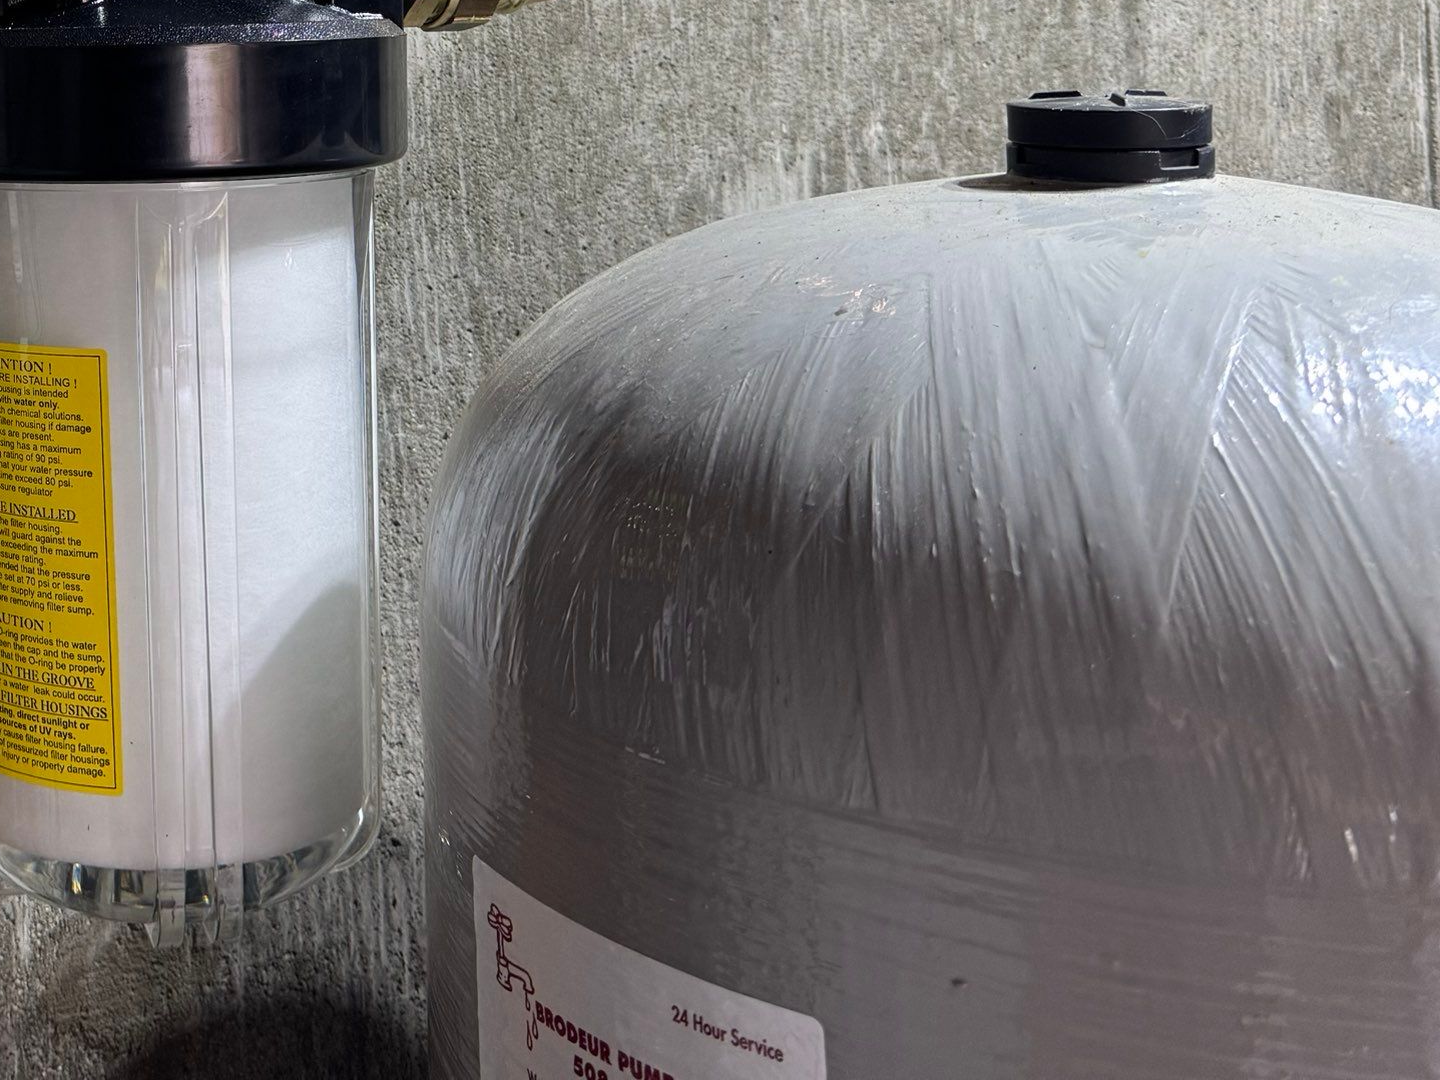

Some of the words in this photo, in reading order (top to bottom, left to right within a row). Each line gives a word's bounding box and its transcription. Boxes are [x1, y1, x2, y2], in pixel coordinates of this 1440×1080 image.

[13, 374, 71, 388] INSTALLING
[23, 387, 31, 395] is
[32, 387, 69, 399] intended
[7, 406, 41, 418] chemical
[43, 411, 84, 421] solutions.
[13, 398, 36, 407] water
[38, 400, 60, 411] only.
[7, 429, 20, 438] are
[21, 432, 55, 442] present.
[15, 420, 46, 432] housing
[55, 424, 92, 435] damage
[16, 440, 31, 451] has
[40, 444, 82, 455] maximum
[3, 450, 24, 463] rating
[35, 453, 46, 463] 90
[48, 456, 63, 465] psi.
[11, 463, 28, 473] your
[29, 465, 52, 475] water
[54, 468, 93, 478] pressure
[14, 474, 43, 485] exceed
[45, 477, 56, 486] 80
[58, 479, 74, 489] psi.
[17, 485, 53, 497] regulator
[9, 502, 76, 521] INSTALLED
[10, 518, 26, 529] filter
[28, 522, 63, 536] housing.
[0, 527, 10, 537] will
[11, 531, 33, 541] guard
[35, 535, 66, 545] against
[67, 537, 82, 547] the
[0, 539, 38, 555] exceeding
[40, 545, 53, 555] the
[55, 548, 99, 559] maximum
[20, 564, 35, 574] that
[37, 567, 50, 577] the
[52, 570, 91, 581] pressure
[26, 576, 36, 586] 70
[38, 579, 50, 588] psi
[62, 581, 83, 592] less.
[10, 586, 35, 599] supply
[37, 591, 52, 600] and
[54, 593, 84, 603] relieve
[9, 597, 45, 612] removing
[46, 601, 65, 612] filter
[67, 605, 95, 616] sump.
[20, 633, 54, 647] provides
[56, 638, 69, 648] the
[71, 641, 97, 651] water
[13, 641, 25, 652] the
[26, 645, 41, 656] cap
[43, 649, 59, 659] and
[60, 650, 75, 660] the
[77, 654, 105, 664] sump.
[0, 649, 14, 661] that
[14, 653, 27, 663] the
[28, 656, 54, 670] O-ring
[55, 660, 66, 670] be
[68, 663, 106, 676] properly
[1, 661, 13, 675] IN
[14, 666, 39, 681] THE
[41, 671, 95, 689] GROOVE
[9, 681, 29, 692] water
[33, 685, 51, 697] leak
[52, 689, 75, 700] could
[77, 693, 106, 703] occur.
[1, 689, 38, 710] FILTER
[40, 699, 108, 719] HOUSINGS
[16, 710, 40, 723] direct
[41, 716, 78, 730] sunlight
[79, 722, 90, 730] or
[3, 729, 24, 741] cause
[43, 738, 76, 753] housing
[78, 742, 108, 755] failure.
[39, 726, 52, 736] UV
[53, 730, 77, 741] rays.
[6, 740, 49, 758] pressurized
[50, 750, 68, 761] filter
[70, 753, 111, 768] housings
[31, 759, 65, 774] property
[66, 764, 107, 779] damage.
[535, 1000, 612, 1066] BRODEUR
[671, 1005, 689, 1028] 24
[693, 1014, 728, 1043] Hour
[730, 1028, 785, 1063] Service
